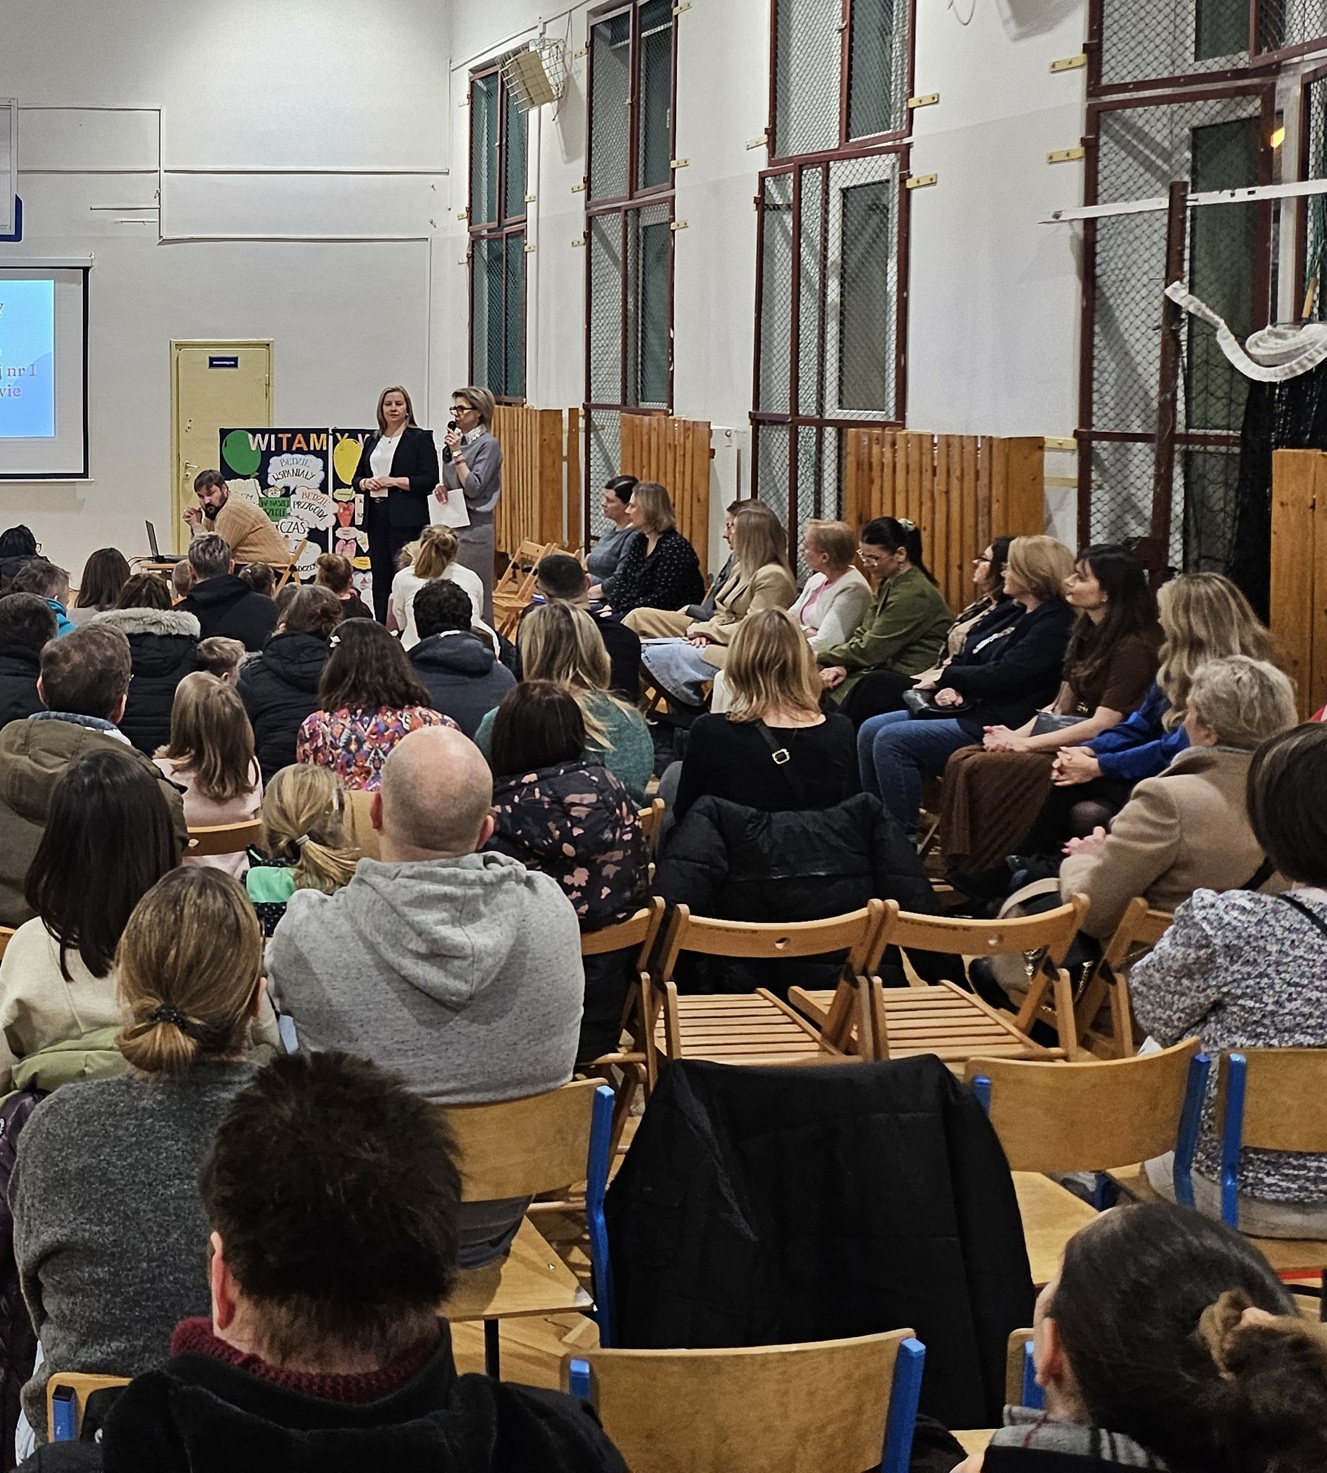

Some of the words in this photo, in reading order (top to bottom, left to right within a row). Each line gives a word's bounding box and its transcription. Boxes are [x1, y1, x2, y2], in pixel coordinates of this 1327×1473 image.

[7, 367, 26, 377] nr
[29, 364, 37, 377] 1
[279, 521, 307, 534] CZAS
